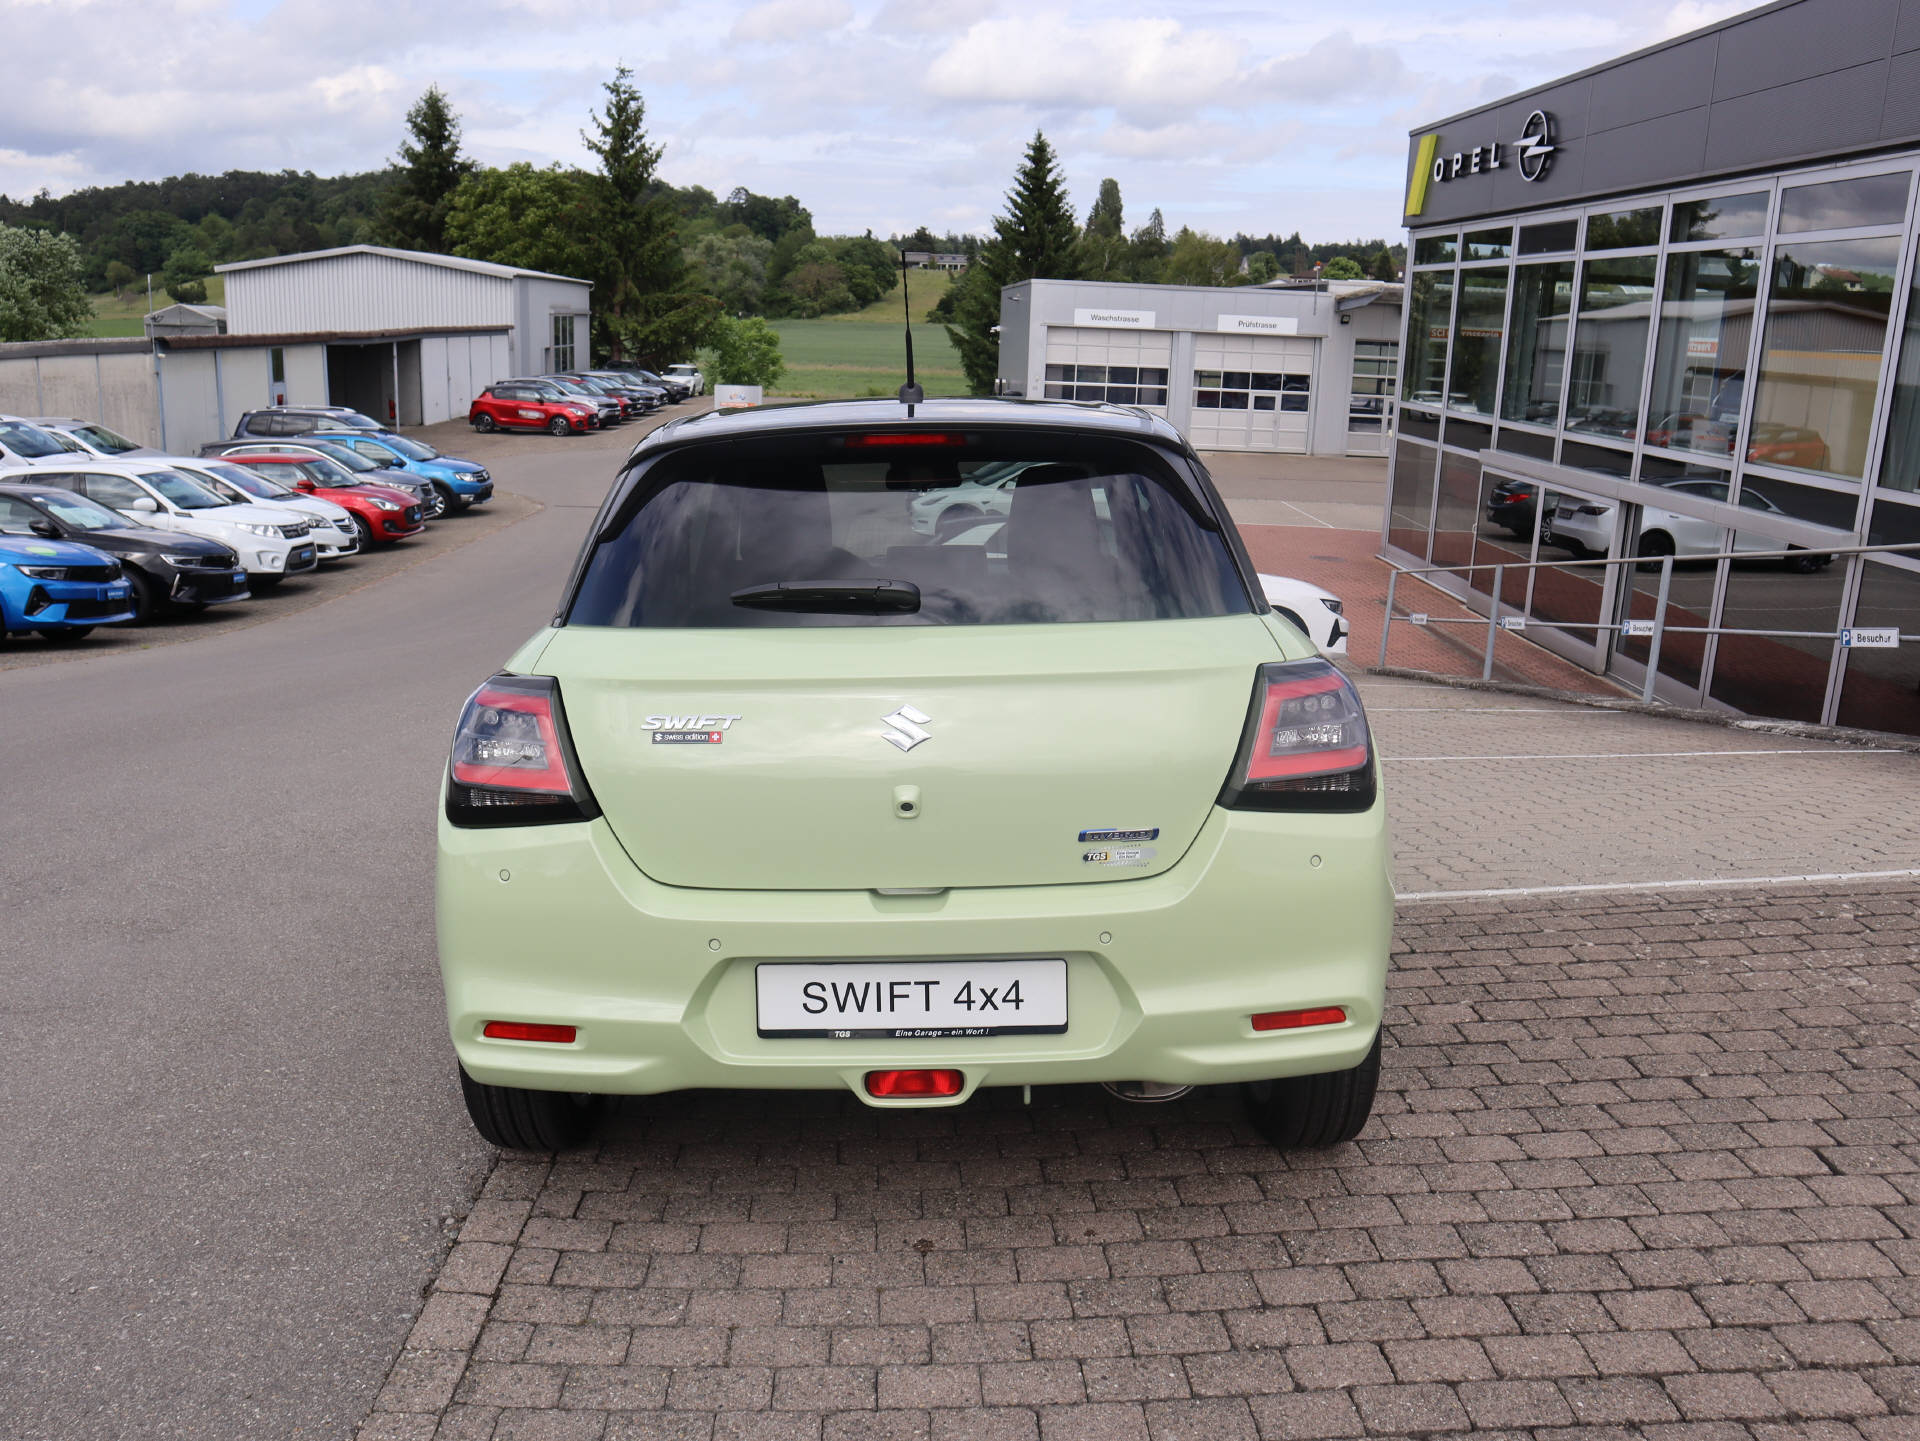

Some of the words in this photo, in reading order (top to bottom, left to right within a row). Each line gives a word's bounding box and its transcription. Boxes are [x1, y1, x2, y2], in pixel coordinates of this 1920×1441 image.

[1434, 142, 1500, 182] OPEL
[1090, 313, 1140, 324] Waschstrasse
[1238, 319, 1278, 330] Prüfstrasse
[1842, 631, 1850, 645] P
[640, 714, 742, 730] SWIFT
[664, 733, 684, 741] swiss
[685, 732, 708, 741] edition
[1087, 852, 1107, 861] TGS
[802, 980, 940, 1014] SWIFT
[953, 979, 1024, 1011] 4x4
[834, 1030, 851, 1038] TGS
[895, 1029, 913, 1037] Eine
[914, 1029, 942, 1038] Garage
